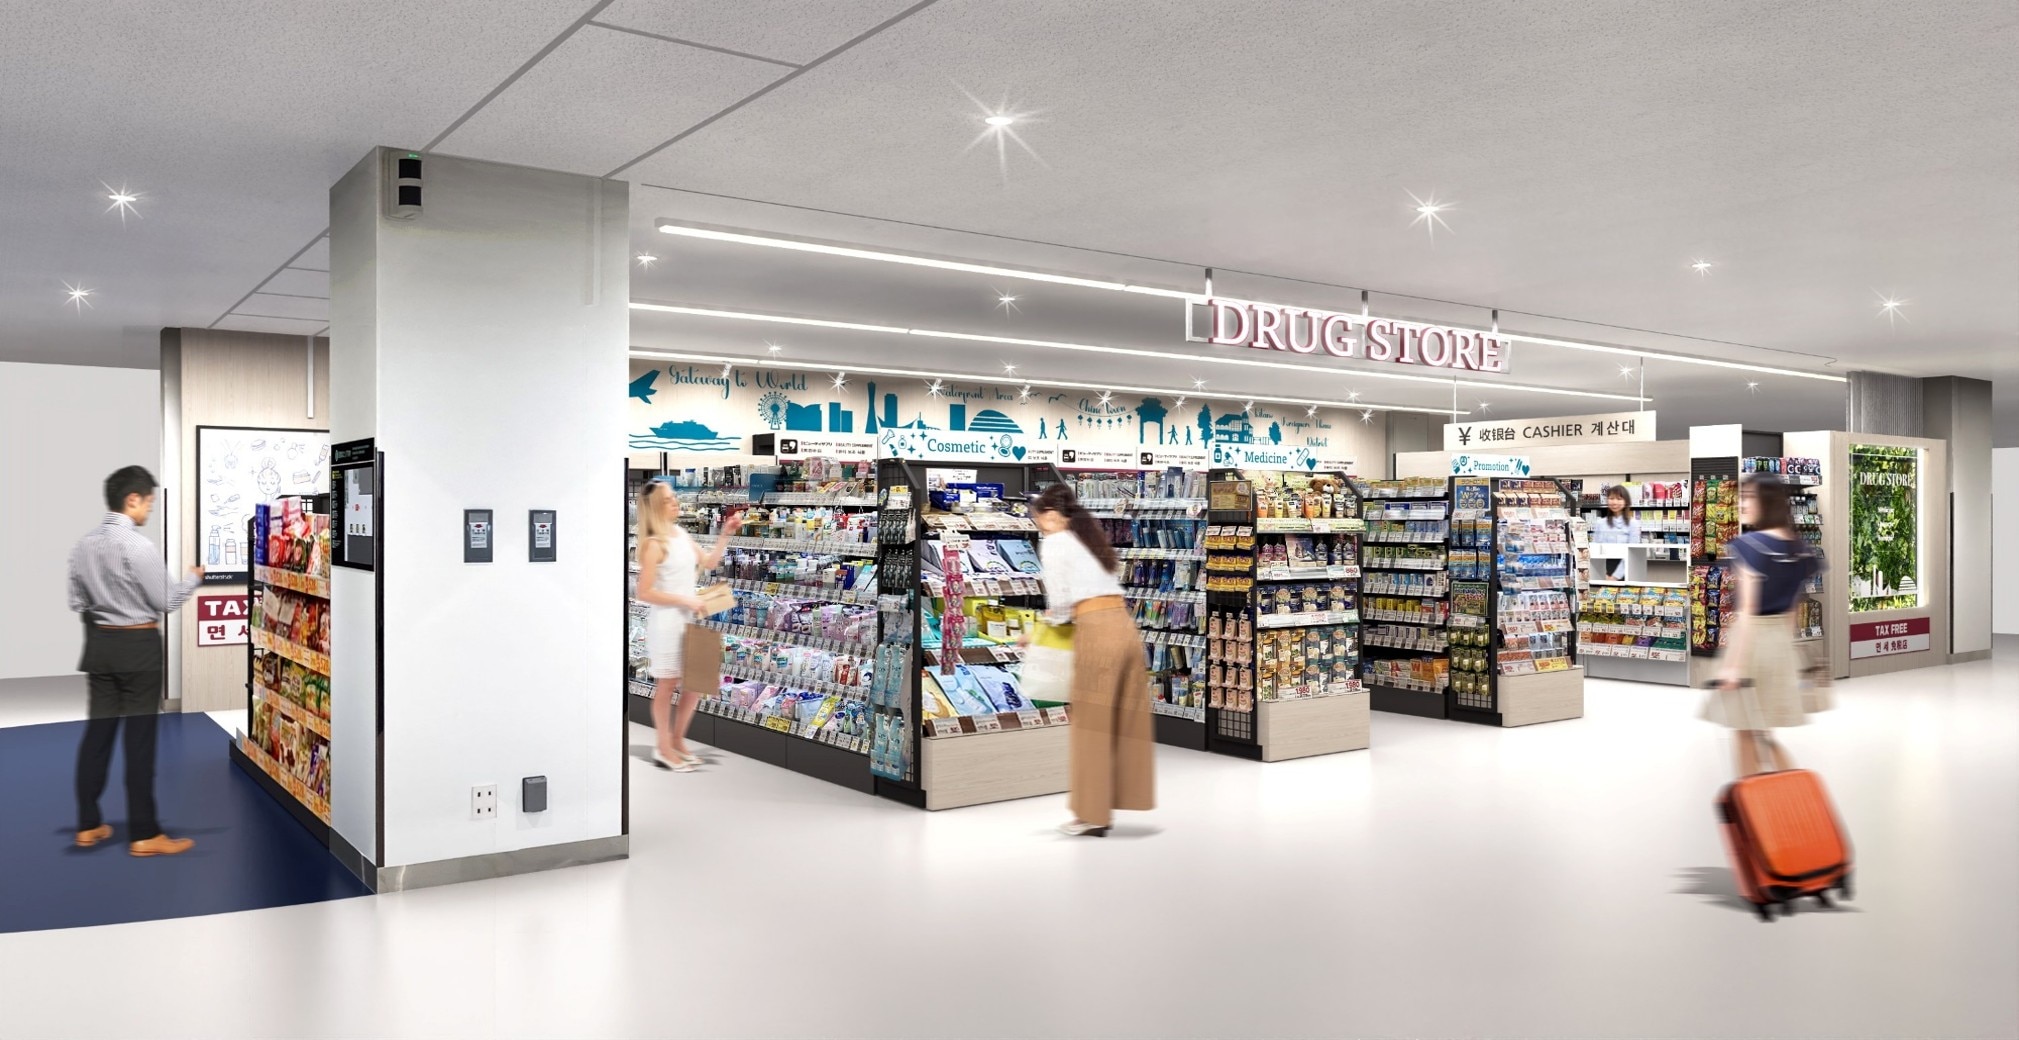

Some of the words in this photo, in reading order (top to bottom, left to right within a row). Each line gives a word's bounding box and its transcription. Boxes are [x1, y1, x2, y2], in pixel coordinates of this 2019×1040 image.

[1209, 299, 1357, 358] DRUG
[1367, 320, 1502, 372] STORE
[669, 364, 730, 400] Gateway
[735, 369, 748, 388] to
[756, 369, 808, 391] World
[1479, 427, 1516, 442] 收银台
[1523, 423, 1583, 439] CASHIER
[927, 438, 986, 454] Cosmetic
[1244, 451, 1288, 465] Medicine
[1473, 460, 1510, 472] Promotion
[1859, 471, 1886, 486] DRUG
[1887, 473, 1912, 487] STORE
[1875, 624, 1890, 637] TAX
[1890, 622, 1908, 635] FREE
